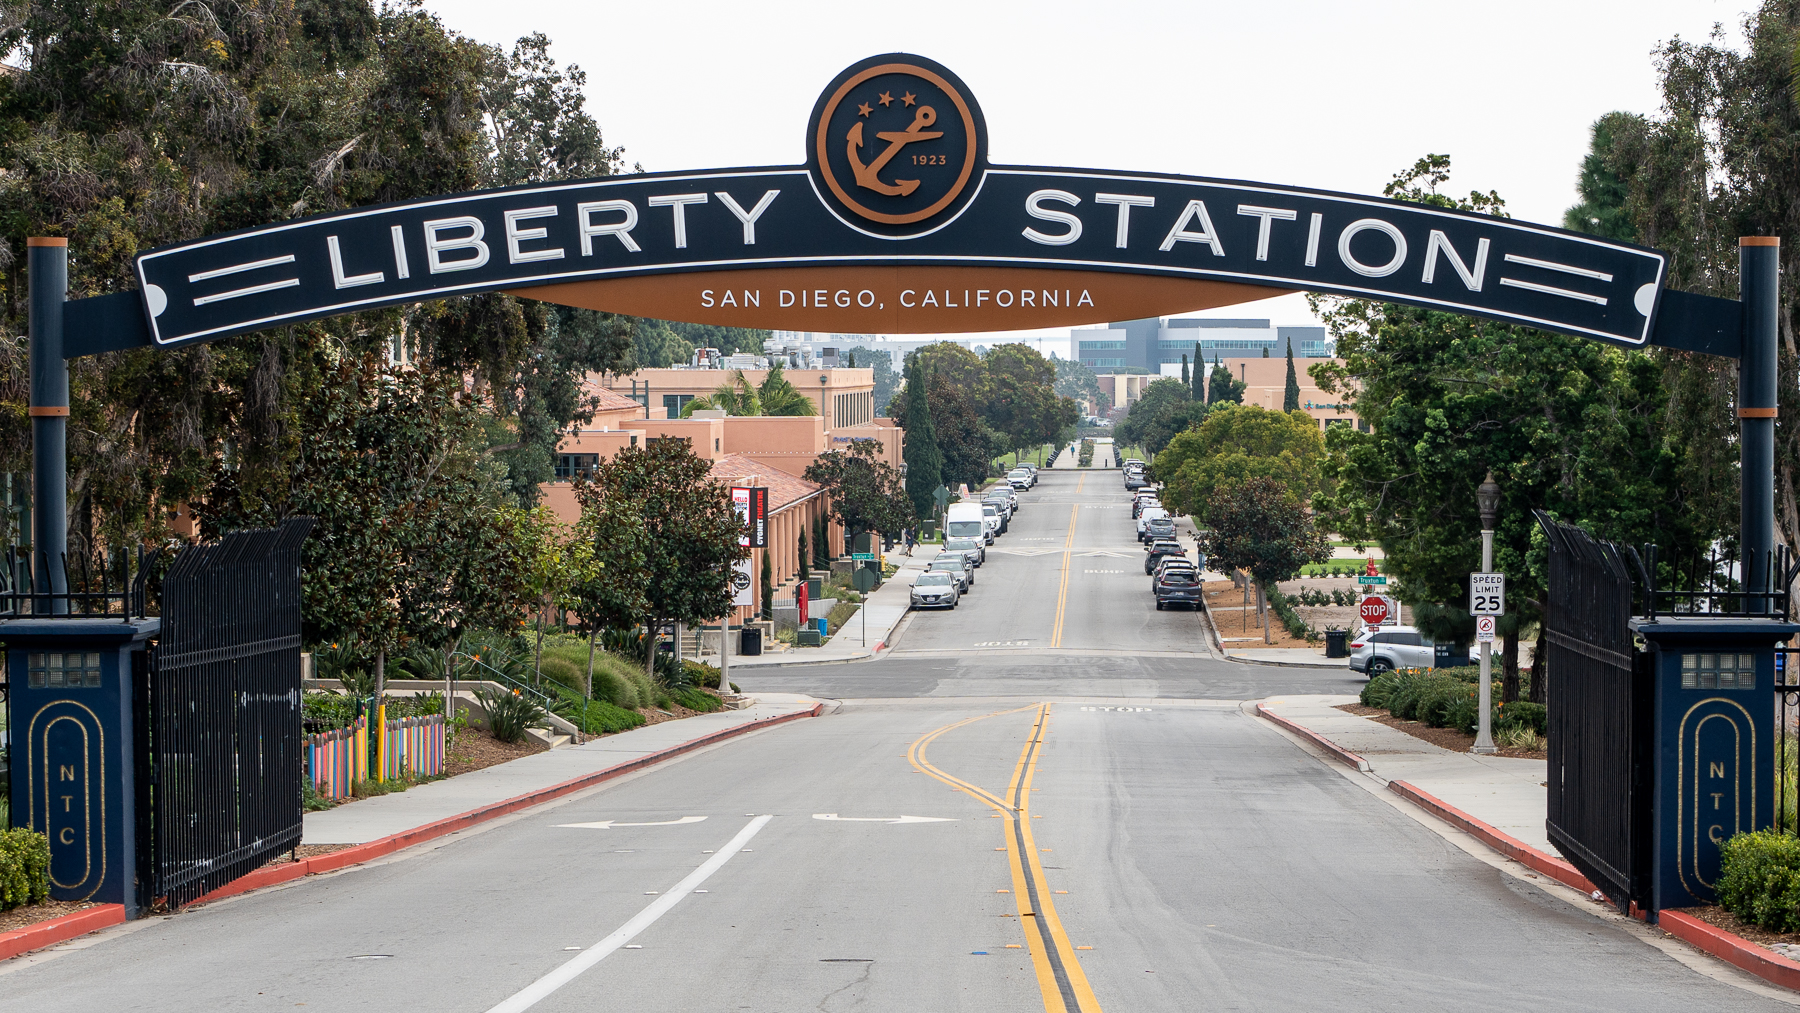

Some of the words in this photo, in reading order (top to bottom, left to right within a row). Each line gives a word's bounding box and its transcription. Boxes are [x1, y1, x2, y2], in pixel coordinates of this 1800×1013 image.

[912, 155, 946, 165] 1923
[327, 189, 781, 290] LIBERTY
[1022, 188, 1491, 293] STATION
[702, 290, 760, 308] SAN
[780, 290, 885, 310] DIEGO,
[900, 290, 1095, 308] CALIFORNIA
[1473, 576, 1502, 584] SPEED
[1361, 604, 1386, 616] STOP
[1474, 595, 1500, 611] 25
